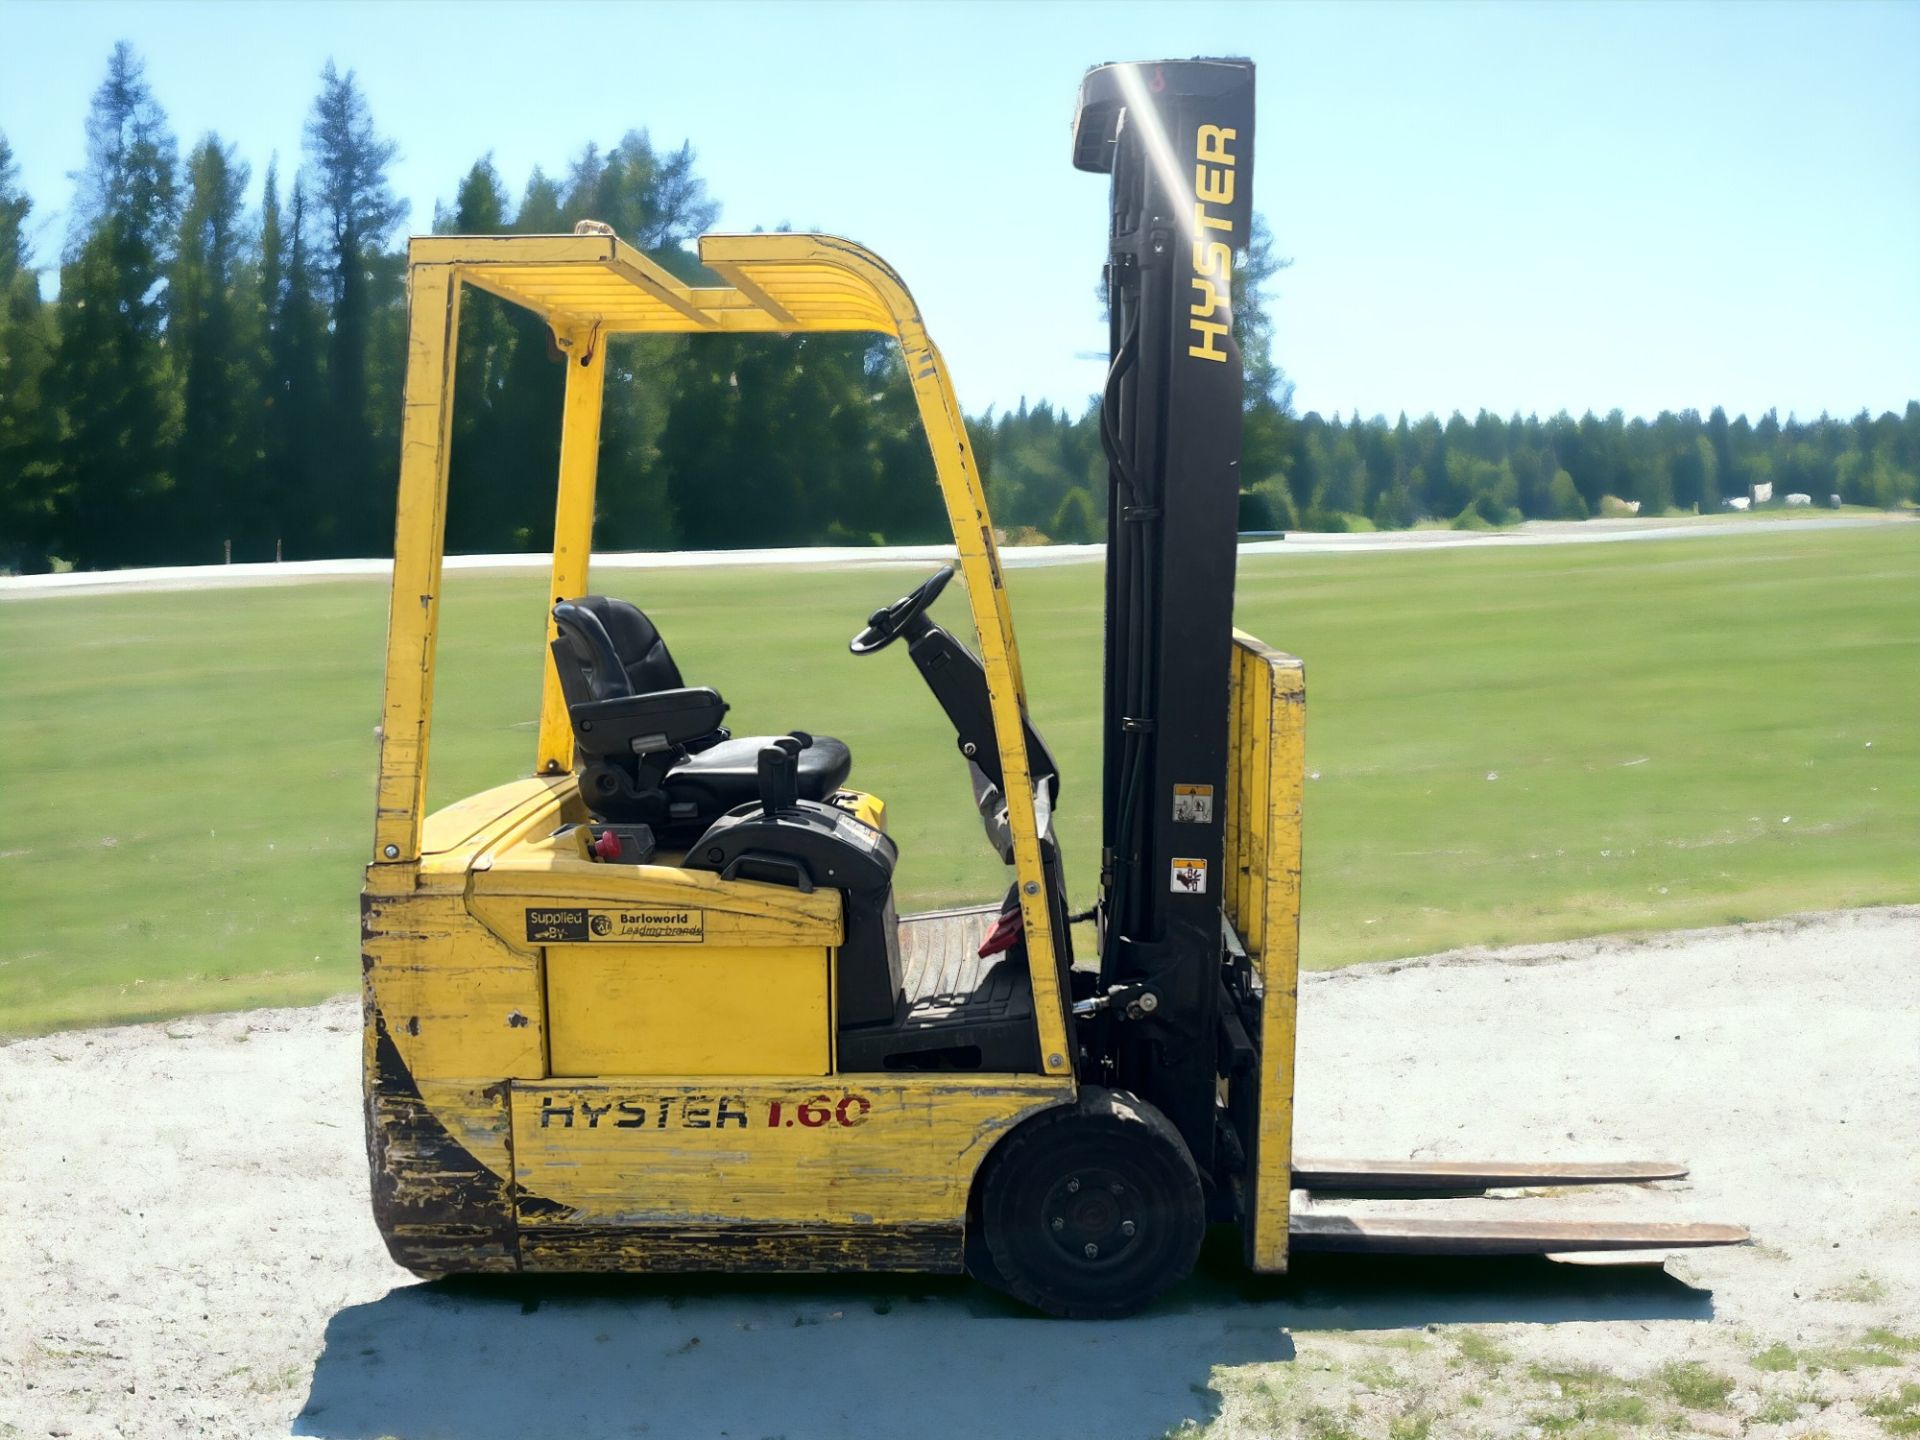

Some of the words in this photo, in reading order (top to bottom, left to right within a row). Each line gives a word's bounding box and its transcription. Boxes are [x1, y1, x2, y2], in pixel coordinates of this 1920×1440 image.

[1189, 124, 1236, 362] HYSTER
[531, 911, 582, 925] Supplied
[620, 913, 688, 924] Barloworld
[540, 1096, 749, 1129] HYSTER
[767, 1093, 872, 1129] 1.60
